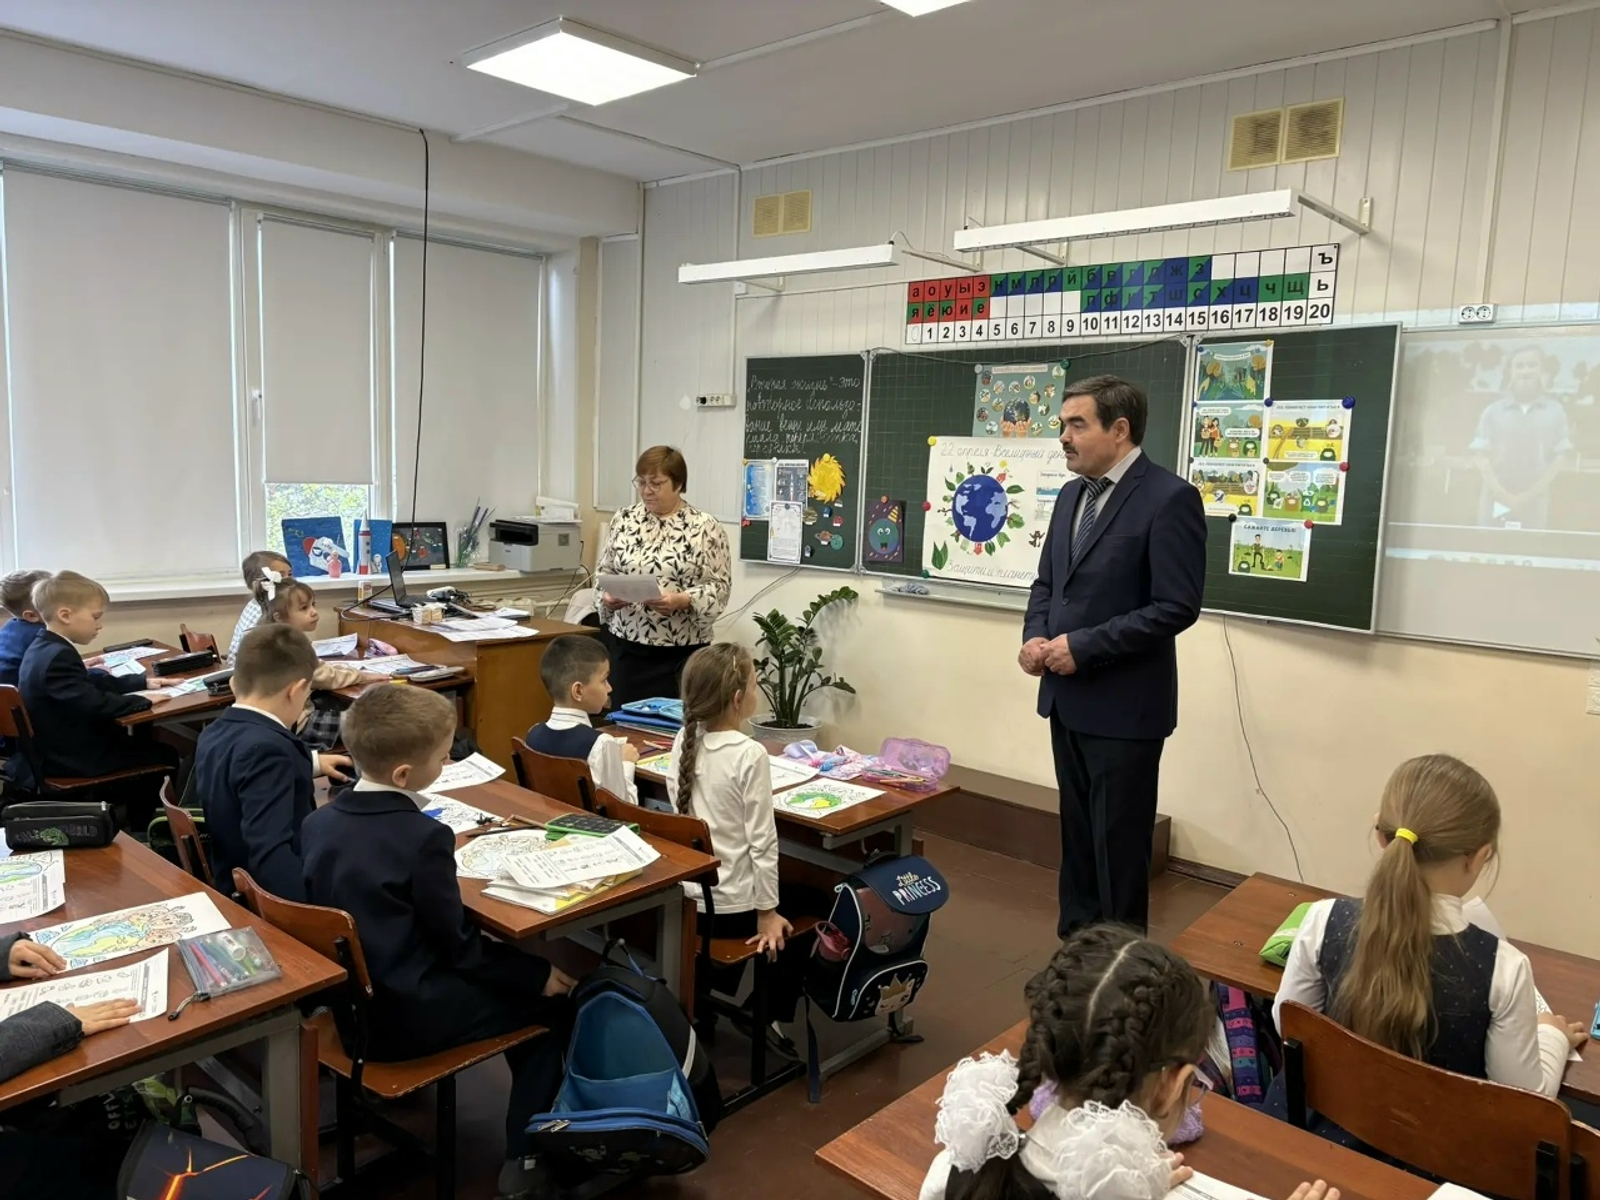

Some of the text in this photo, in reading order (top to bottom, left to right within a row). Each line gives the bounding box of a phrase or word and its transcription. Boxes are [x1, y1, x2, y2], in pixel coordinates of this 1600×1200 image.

[912, 287, 920, 297] а
[928, 286, 936, 296] о
[944, 284, 952, 298] у
[959, 283, 970, 294] ы
[978, 282, 986, 292] э
[1011, 279, 1020, 289] м
[1049, 275, 1056, 287] р
[1068, 269, 1076, 284] й
[1087, 267, 1096, 282] б
[1107, 270, 1116, 281] в
[1170, 265, 1182, 276] ж
[1195, 263, 1204, 275] з
[911, 308, 919, 318] я
[927, 304, 935, 317] ё
[941, 305, 953, 316] ю
[960, 304, 968, 315] и
[977, 303, 984, 314] е
[1087, 296, 1096, 306] п
[1104, 290, 1117, 308] ф
[1148, 291, 1158, 303] т
[1194, 288, 1202, 299] с
[1216, 286, 1226, 298] х
[1265, 282, 1276, 294] ч
[1287, 281, 1304, 295] щ
[927, 328, 932, 340] 1
[942, 326, 950, 338] 2
[959, 326, 966, 338] 3
[976, 324, 983, 337] 4
[993, 324, 1000, 336] 5
[1011, 322, 1018, 335] 6
[1029, 322, 1036, 334] 7
[1047, 320, 1055, 333] 8
[1066, 319, 1074, 332] 9
[1082, 317, 1098, 331] 10
[1104, 316, 1118, 330] 11
[1123, 314, 1140, 329] 12
[1144, 313, 1161, 328] 13
[1166, 312, 1183, 326] 14
[1188, 311, 1206, 326] 15
[1211, 310, 1230, 324] 16
[1235, 308, 1254, 323] 17
[1260, 306, 1278, 322] 18
[1284, 305, 1304, 320] 19
[1309, 303, 1330, 319] 20
[941, 442, 954, 456] 22
[892, 876, 940, 905] PRINCESS
